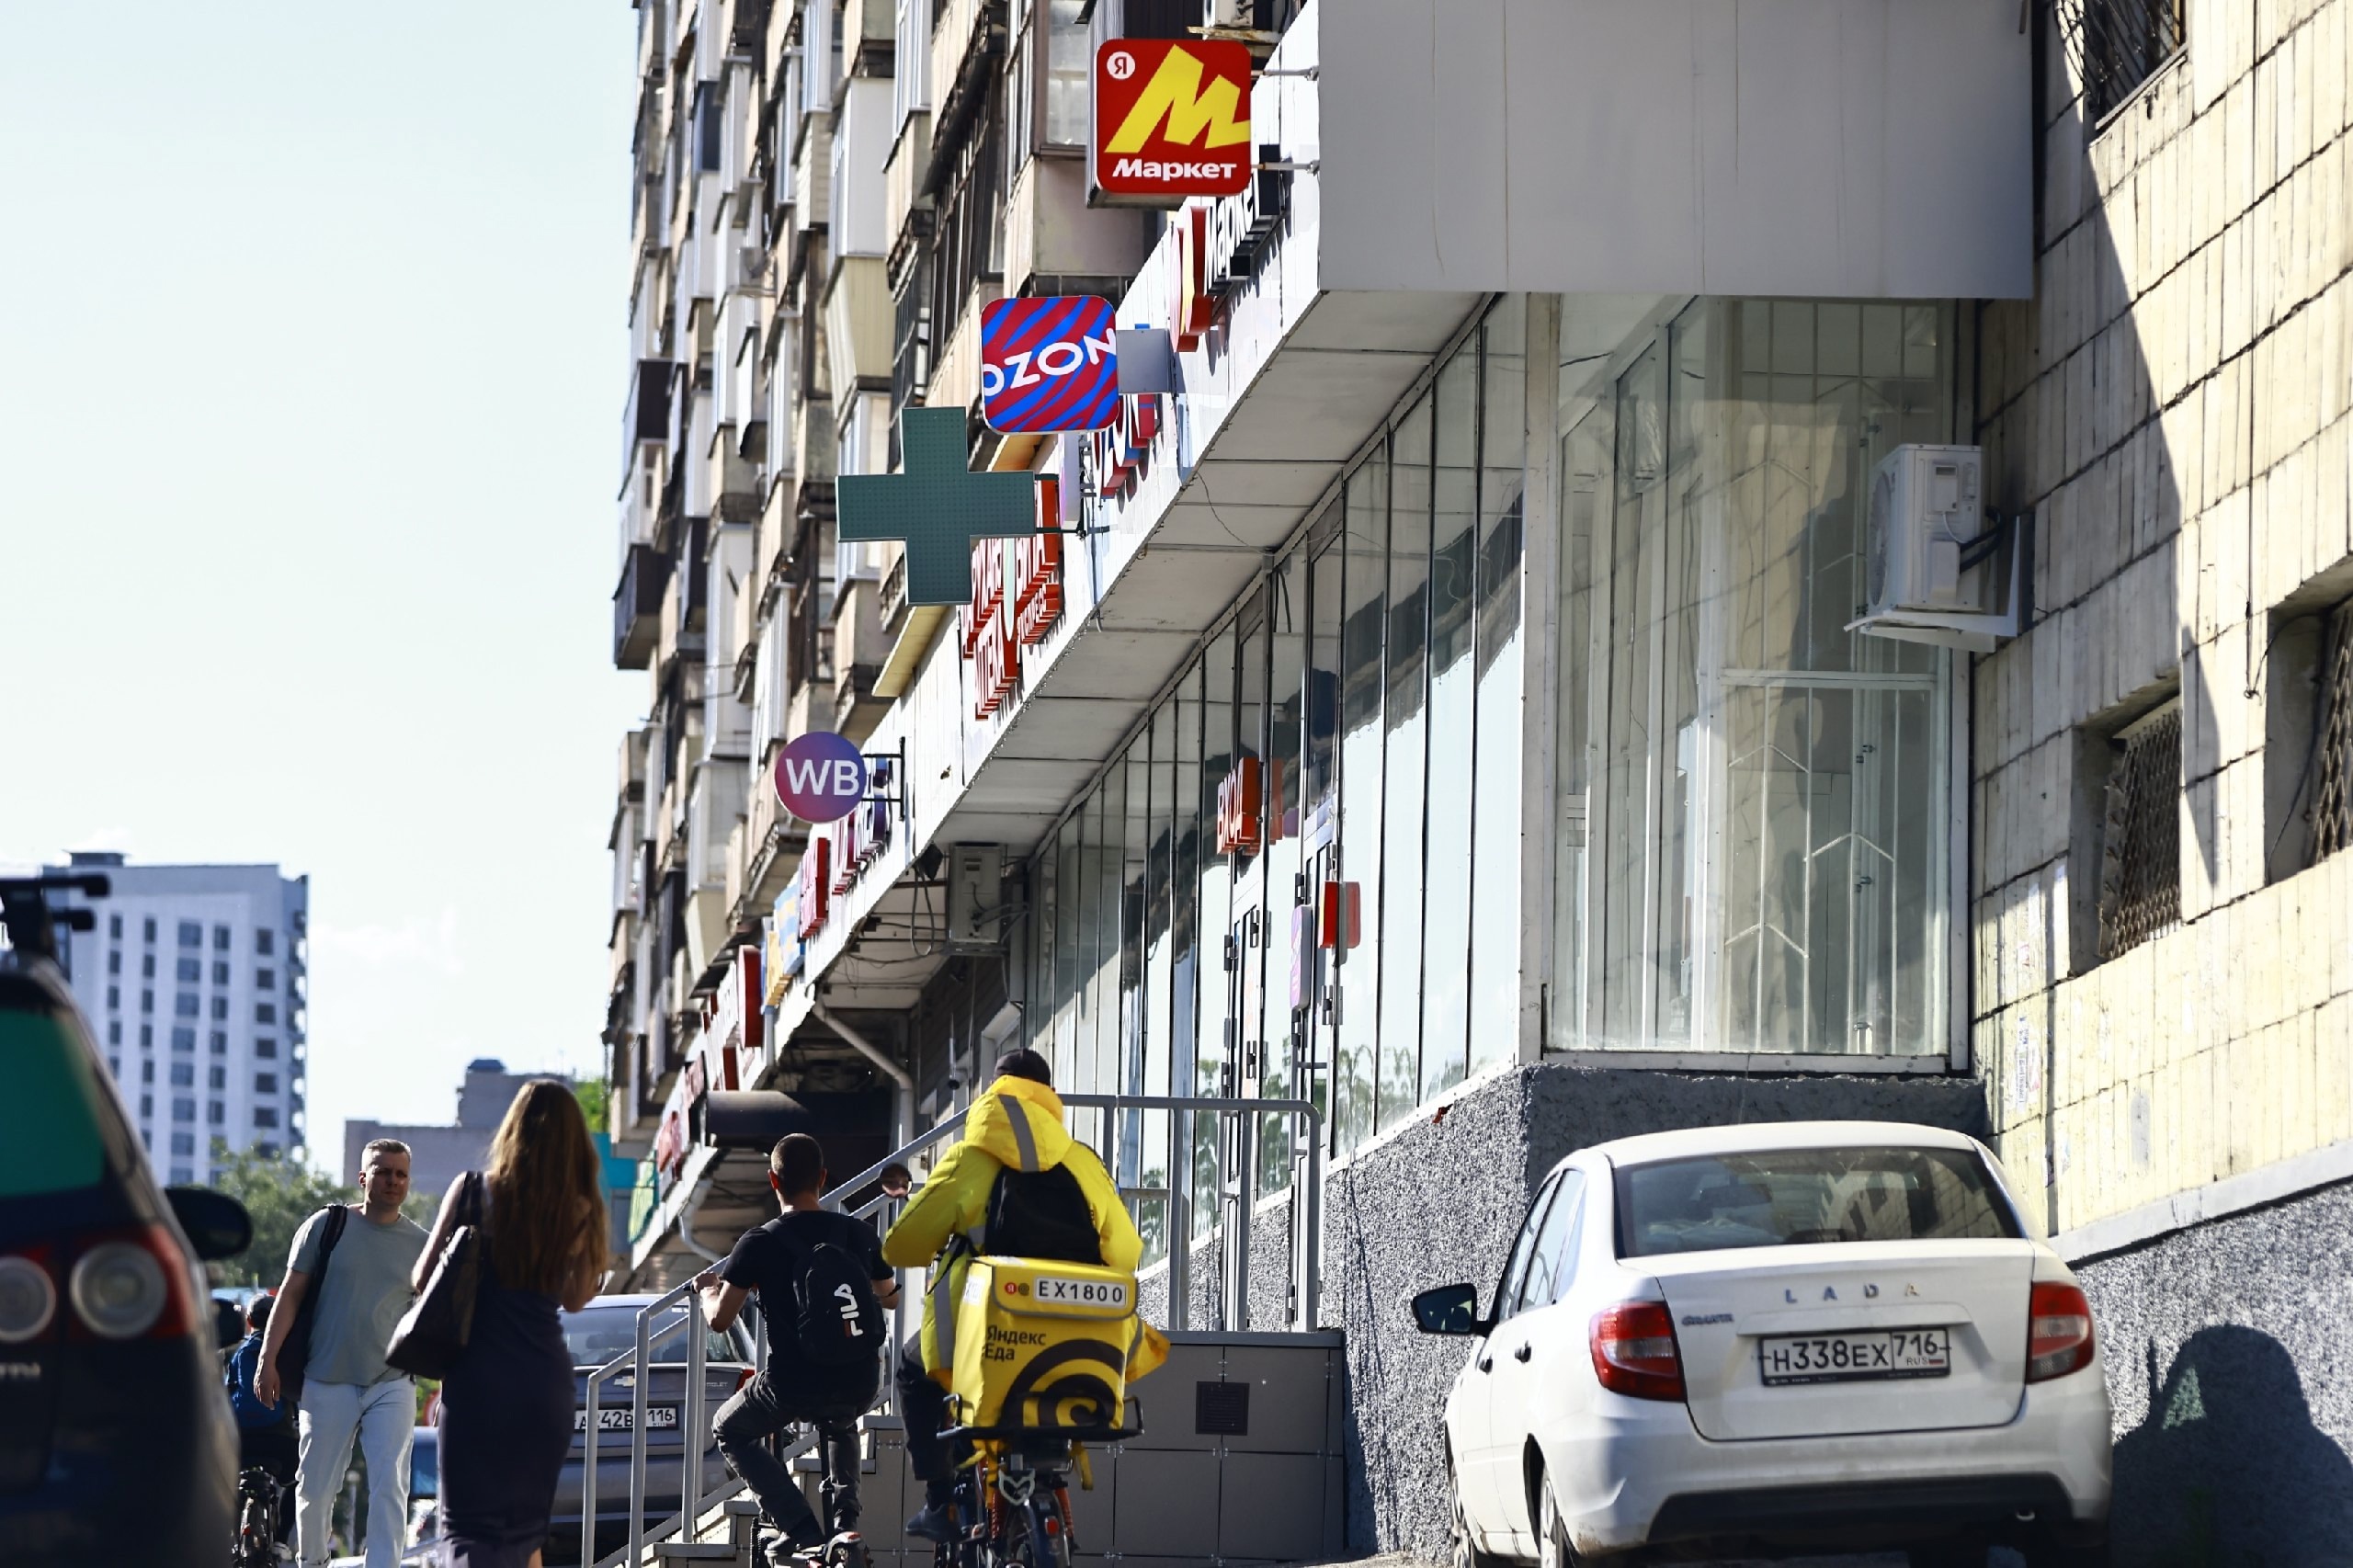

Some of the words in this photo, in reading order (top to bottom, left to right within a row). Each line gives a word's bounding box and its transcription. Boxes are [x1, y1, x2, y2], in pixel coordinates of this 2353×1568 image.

[1113, 55, 1128, 74] Я
[1112, 158, 1237, 181] Маркет
[983, 328, 1117, 396] OZON
[974, 602, 1006, 717] АПТЕКА
[786, 758, 859, 796] WB
[1217, 757, 1245, 854] ВХОД
[1785, 1283, 1919, 1303] LADA
[834, 1283, 863, 1337] FILA
[987, 1324, 1046, 1346] Яндекс
[1893, 1334, 1938, 1357] 716
[984, 1343, 1015, 1362] Еда
[1906, 1357, 1927, 1366] RUS
[647, 1409, 673, 1422] 116
